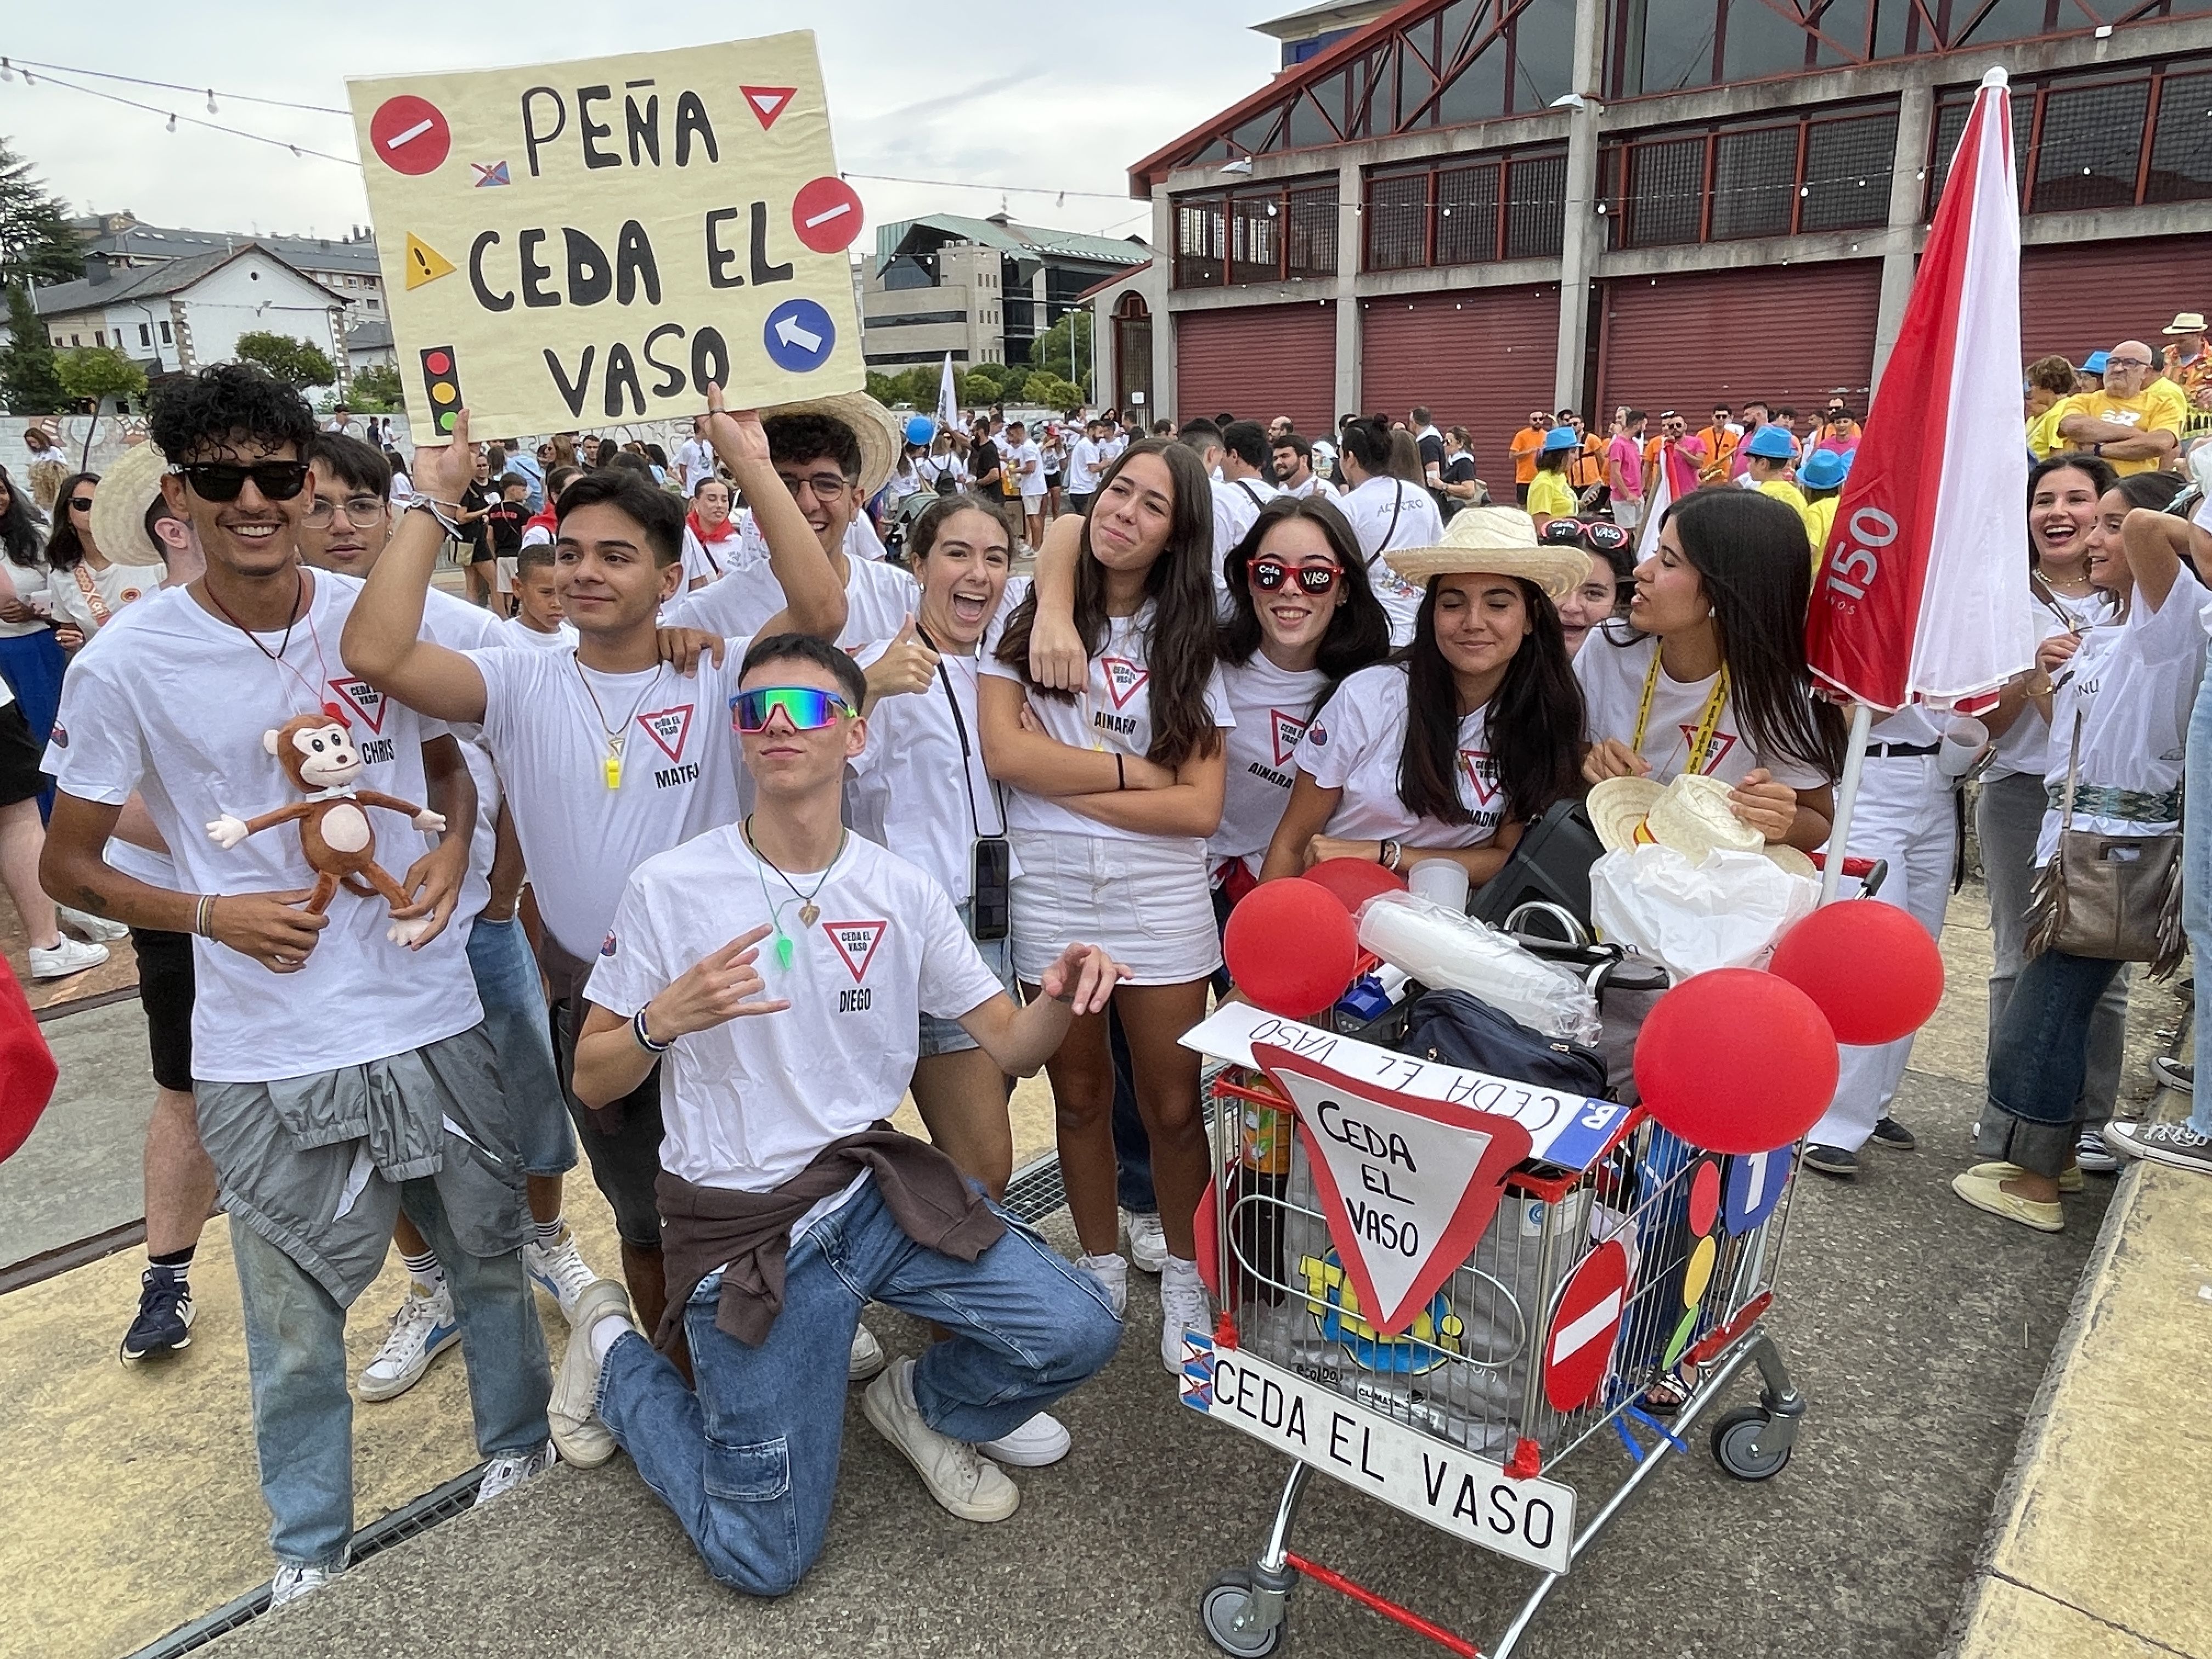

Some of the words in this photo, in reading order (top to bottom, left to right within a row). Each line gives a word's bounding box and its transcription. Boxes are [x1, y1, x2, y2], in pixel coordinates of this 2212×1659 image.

[521, 79, 719, 177] PEÑA
[469, 219, 662, 313] CEDA
[706, 201, 794, 289] EL
[543, 323, 730, 419] VASO
[1259, 565, 1280, 575] Ceda
[1827, 506, 1898, 600] 150
[1303, 572, 1330, 585] VASO
[359, 694, 379, 705] VASO
[362, 739, 395, 765] CHRIS
[1248, 762, 1294, 789] AINARA
[842, 932, 862, 941] CEDA
[863, 932, 871, 940] EL
[848, 942, 867, 951] VASO
[839, 988, 871, 1013] DIEGO
[1249, 1019, 1339, 1064] VASO
[1376, 1056, 1424, 1091] EL
[1446, 1076, 1560, 1131] CEDA
[1317, 1100, 1417, 1173] CEDA
[1362, 1163, 1415, 1205] EL
[1346, 1197, 1419, 1257] VASO
[1214, 1359, 1308, 1446] CEDA
[1329, 1412, 1385, 1482] EL
[1423, 1453, 1555, 1549] VASO
